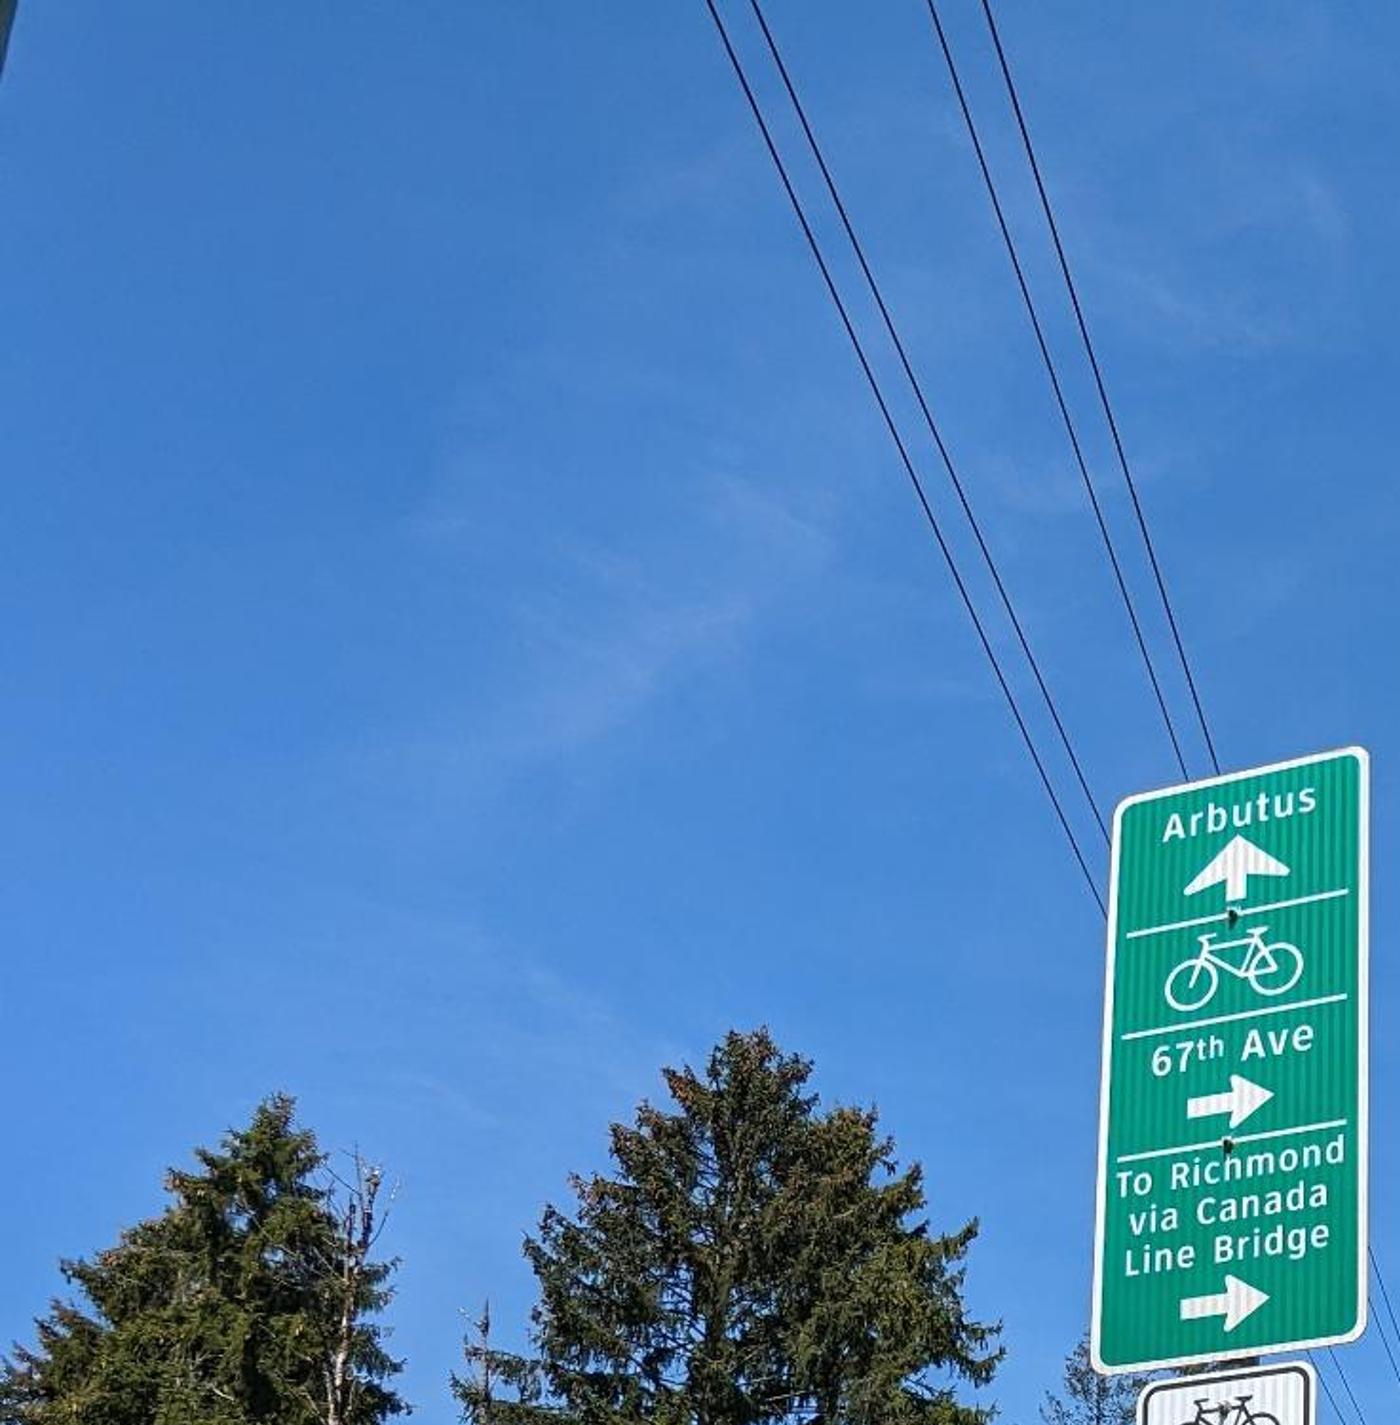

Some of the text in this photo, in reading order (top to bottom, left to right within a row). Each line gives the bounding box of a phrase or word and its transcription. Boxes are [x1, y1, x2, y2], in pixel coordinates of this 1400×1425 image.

[1162, 787, 1317, 843] Arbutus
[1152, 1024, 1315, 1076] 67th Ave
[1116, 1133, 1345, 1198] To Richmond
[1129, 1180, 1328, 1236] via Canada
[1124, 1223, 1330, 1277] Line Bridge
